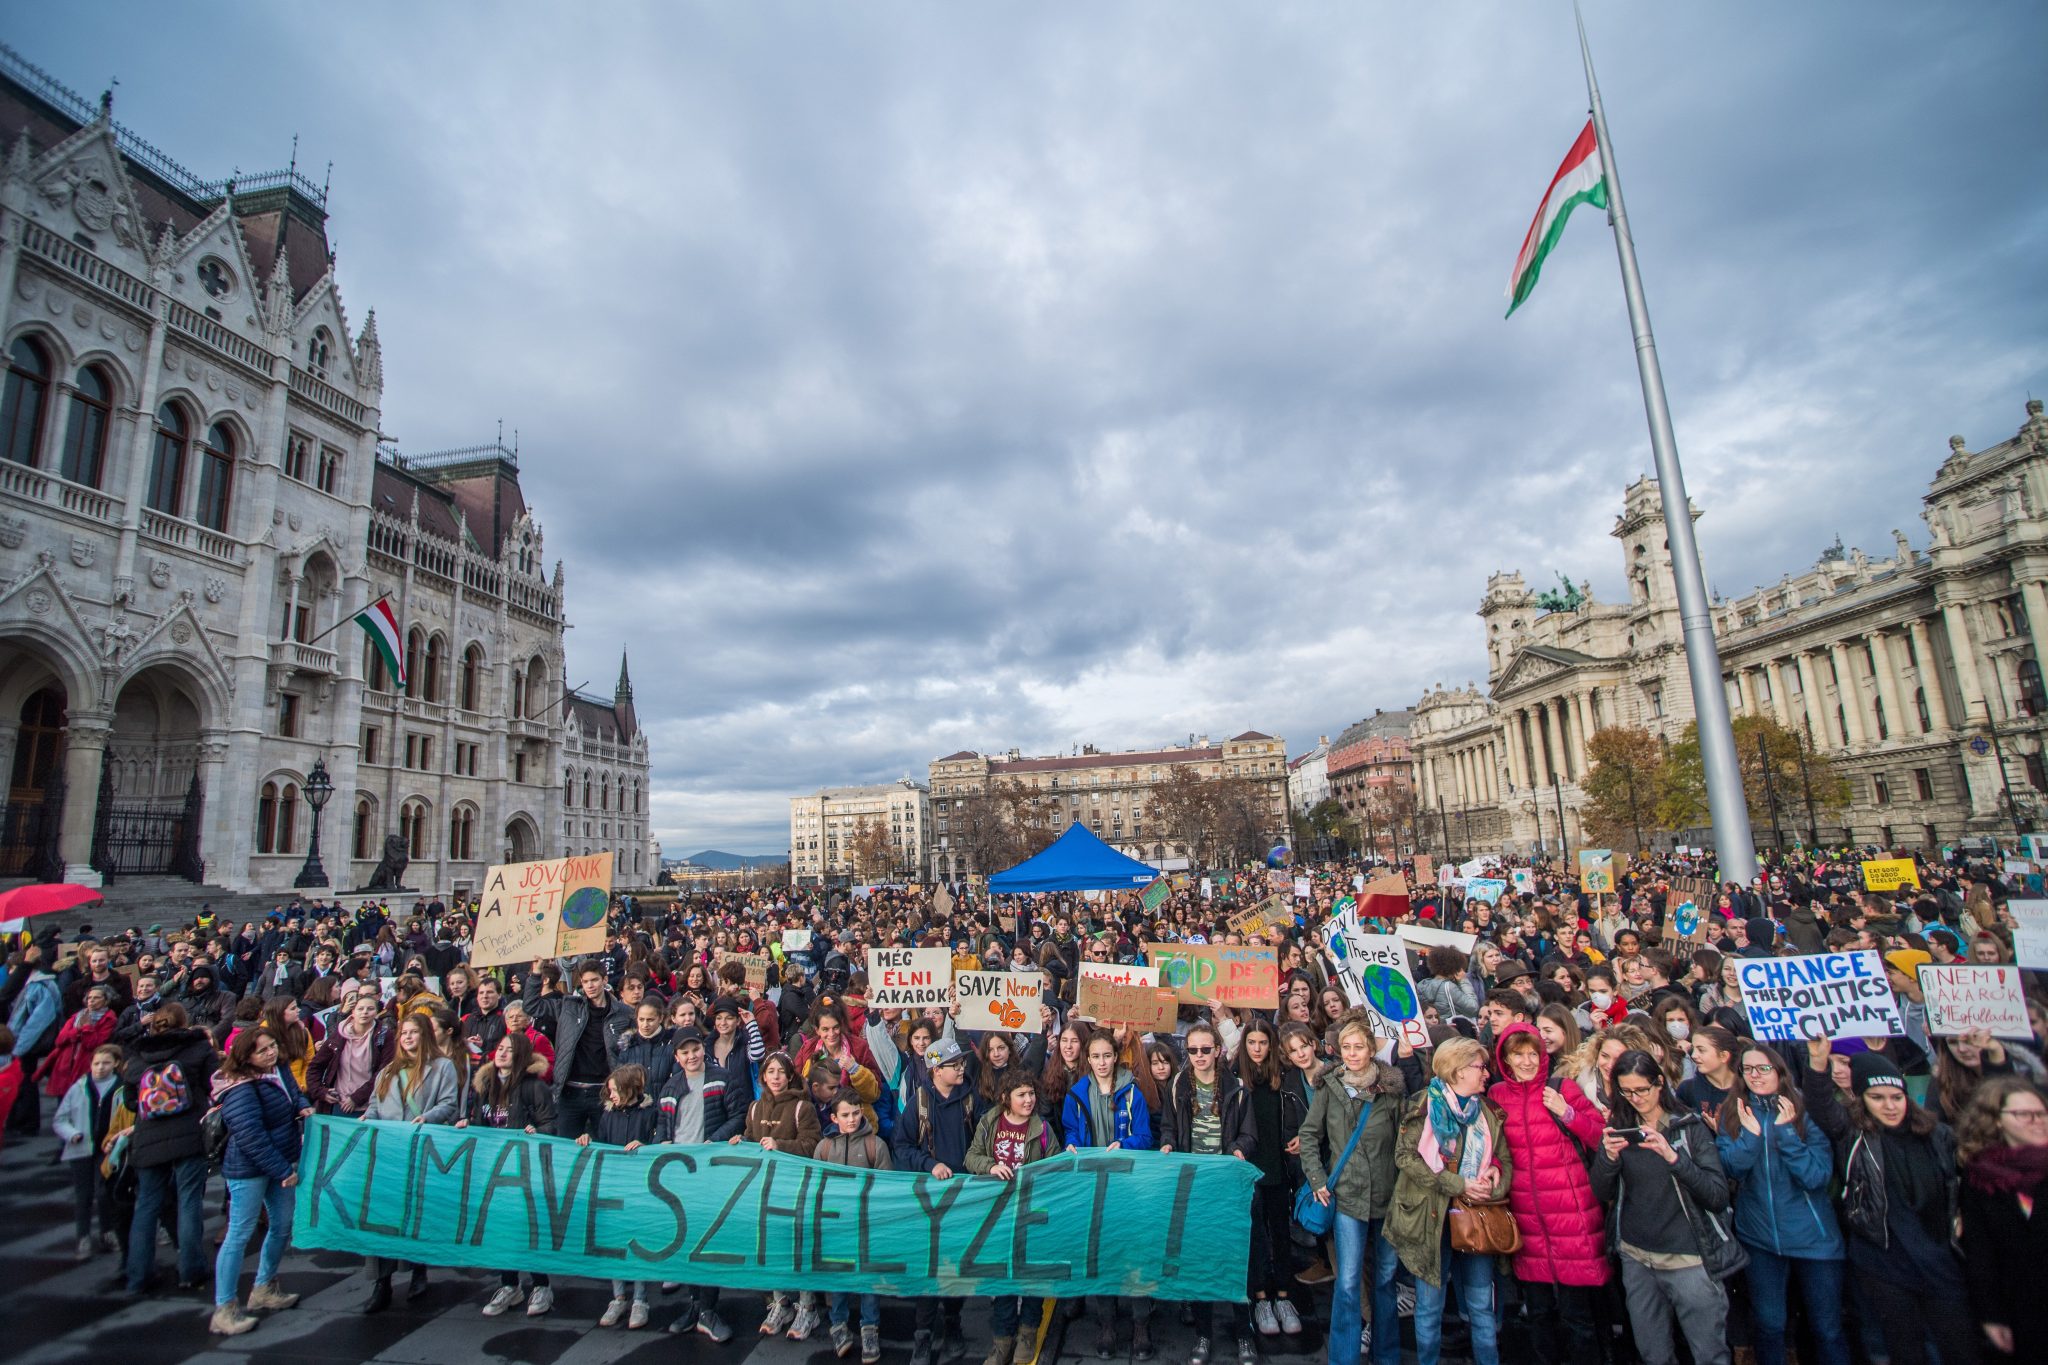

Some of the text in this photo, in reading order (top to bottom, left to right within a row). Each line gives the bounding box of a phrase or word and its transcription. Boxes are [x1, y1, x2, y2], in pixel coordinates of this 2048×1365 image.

[490, 858, 603, 892] A JÖVŐNK
[1699, 879, 1713, 896] YOU
[485, 886, 562, 918] A TÉT
[1240, 900, 1274, 921] VAGYUNK
[1693, 892, 1712, 912] YOUR
[535, 925, 545, 936] B
[877, 949, 913, 967] MÉG
[1347, 937, 1400, 966] There's
[883, 967, 932, 987] ÉLNI
[1230, 962, 1257, 981] DE
[1742, 952, 1872, 989] CHANGE
[1936, 967, 1990, 986] NEM
[958, 974, 1001, 997] SAVE
[1744, 976, 1889, 1008] THE POLITICS
[1938, 987, 2021, 1003] AKAROK
[1748, 1005, 1802, 1026] NOT
[1756, 1004, 1903, 1042] THE CLIMATE
[1402, 1018, 1427, 1049] B
